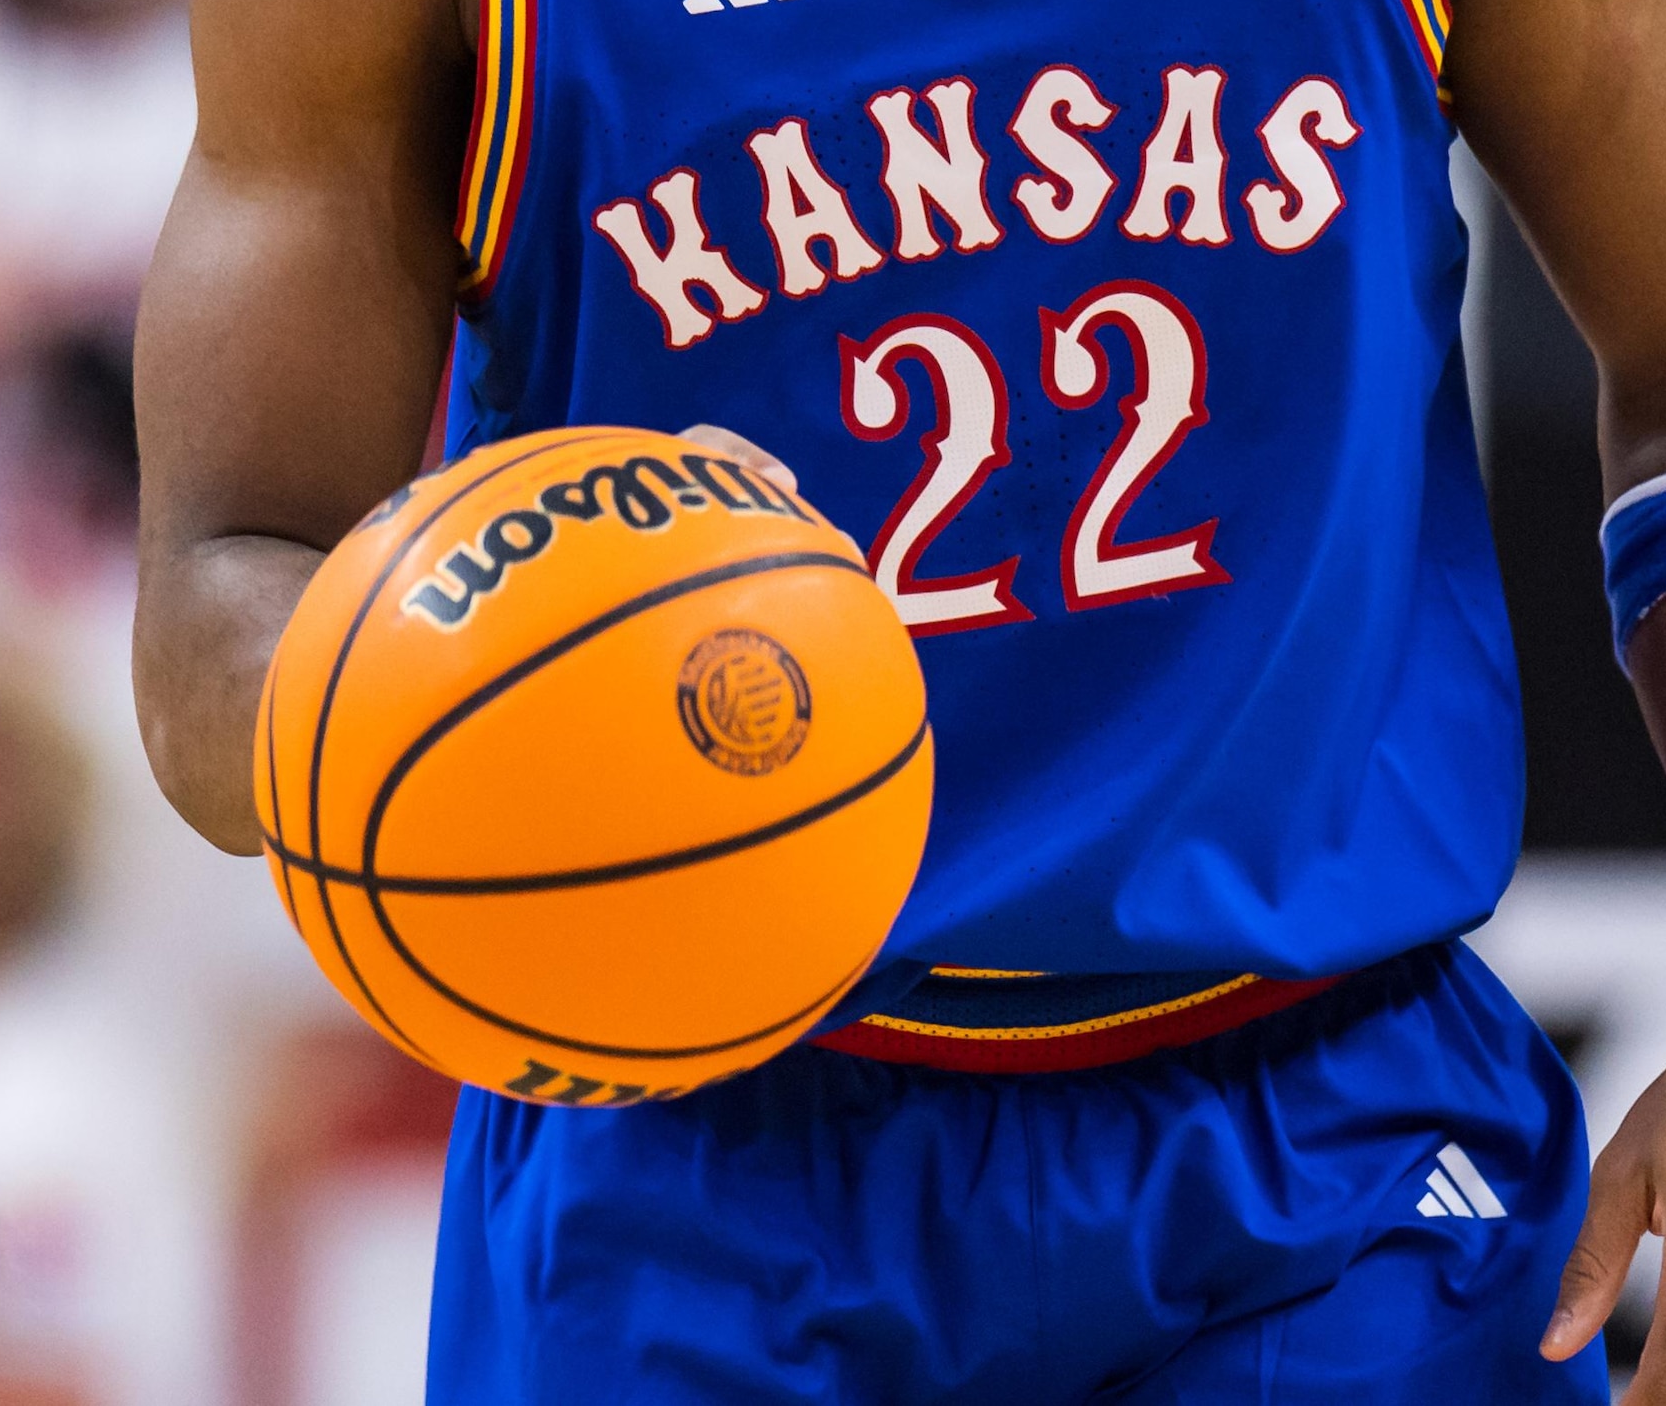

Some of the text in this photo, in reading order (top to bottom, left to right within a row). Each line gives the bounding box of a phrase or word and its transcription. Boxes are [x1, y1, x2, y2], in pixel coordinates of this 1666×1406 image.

[592, 62, 1363, 351] KANSAS
[401, 451, 818, 633] Wilson
[837, 279, 1234, 637] 22
